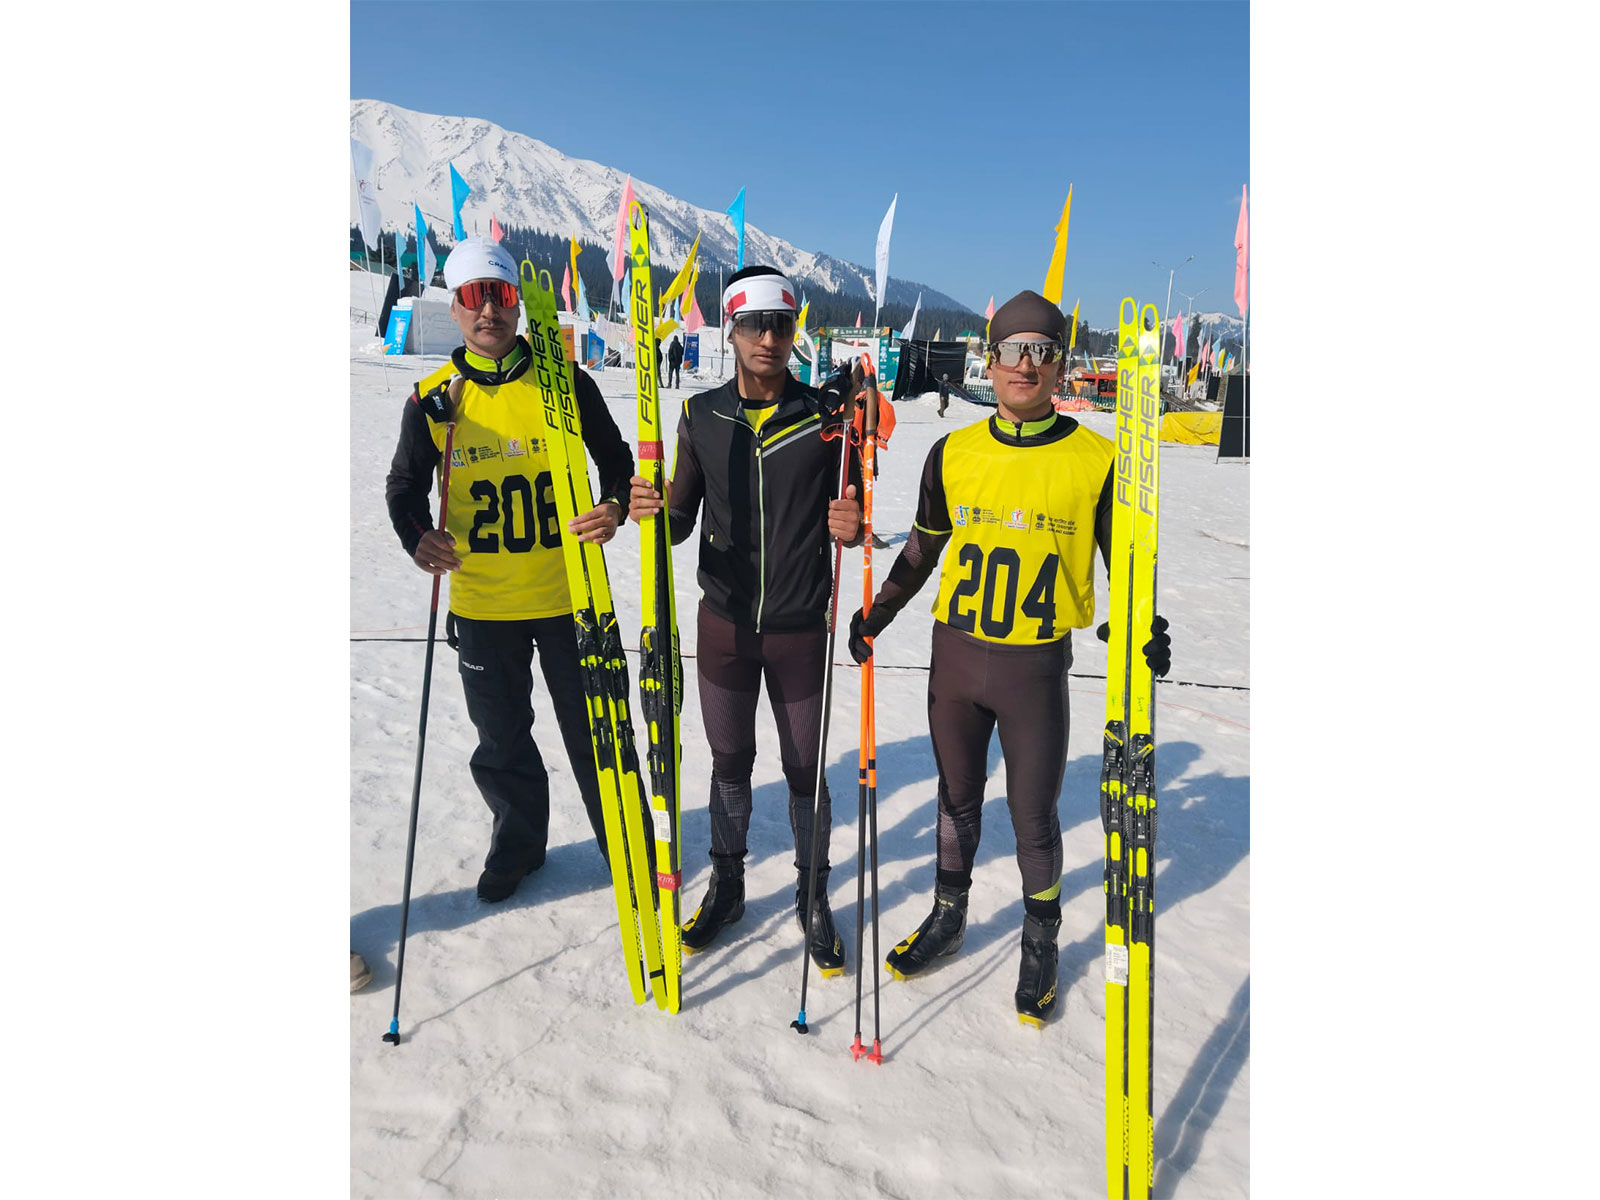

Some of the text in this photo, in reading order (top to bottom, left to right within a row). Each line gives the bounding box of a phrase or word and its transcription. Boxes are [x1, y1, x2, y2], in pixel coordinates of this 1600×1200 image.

[530, 318, 559, 430] FISCHER
[547, 326, 579, 436] FISCHER
[635, 279, 653, 425] FISCHER
[1117, 368, 1134, 507] FISCHER
[1139, 375, 1156, 517] FISCHER
[469, 470, 563, 554] 206
[947, 542, 1060, 640] 204
